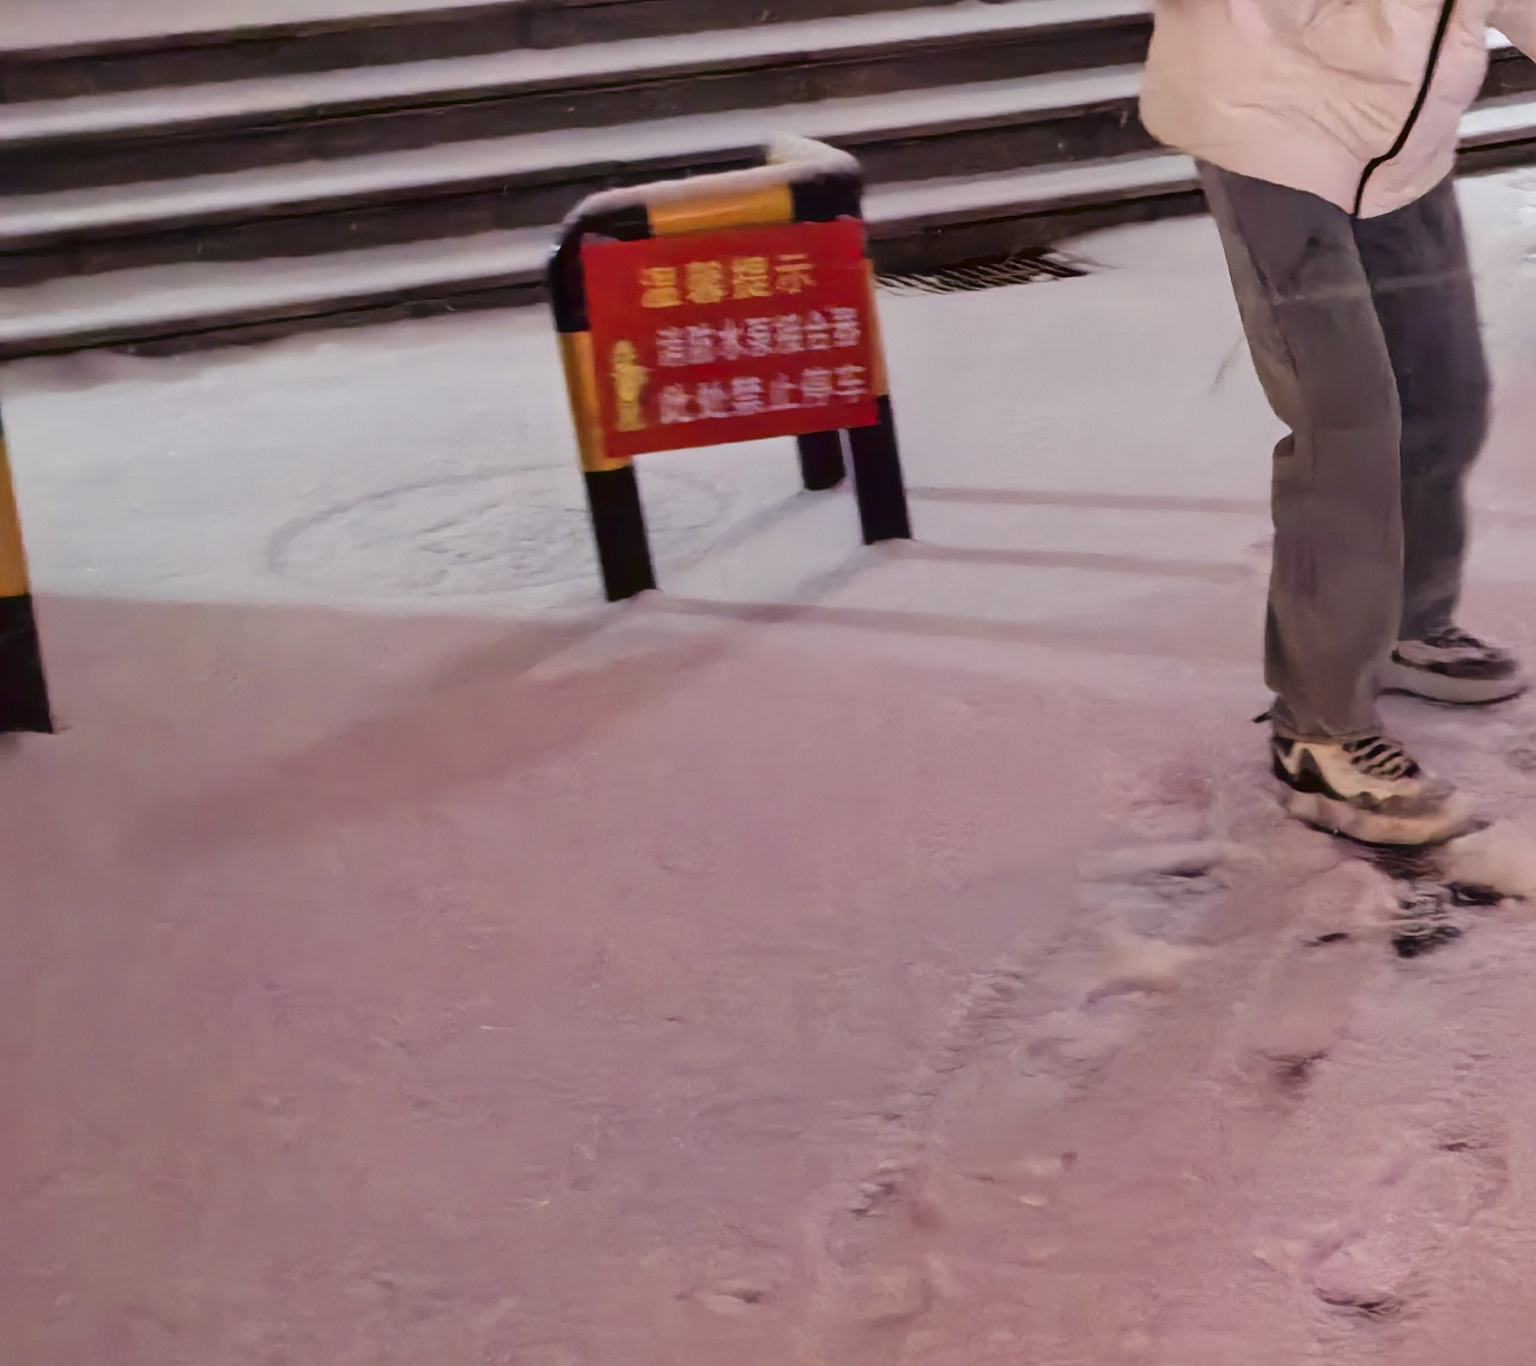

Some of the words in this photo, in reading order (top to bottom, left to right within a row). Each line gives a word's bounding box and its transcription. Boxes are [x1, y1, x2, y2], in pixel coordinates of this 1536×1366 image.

[638, 251, 817, 308] 温馨提示
[660, 363, 867, 424] 此处禁止停车
